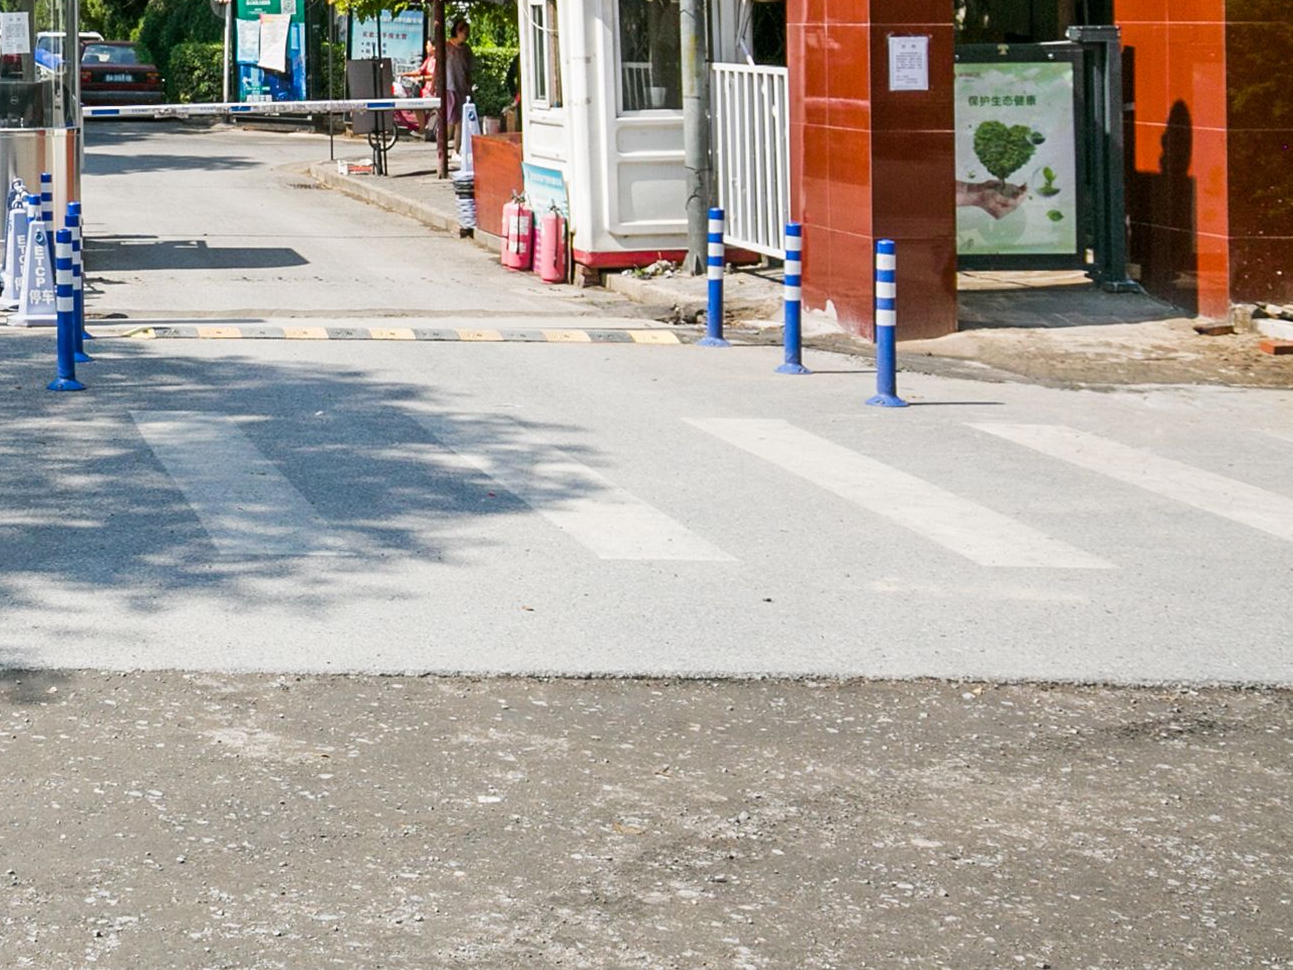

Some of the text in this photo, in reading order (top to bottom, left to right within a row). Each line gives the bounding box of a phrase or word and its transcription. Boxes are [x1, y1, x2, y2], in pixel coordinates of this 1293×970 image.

[968, 95, 1037, 107] 保护生态健康
[34, 246, 46, 287] ETCP
[29, 289, 55, 305] 停车
